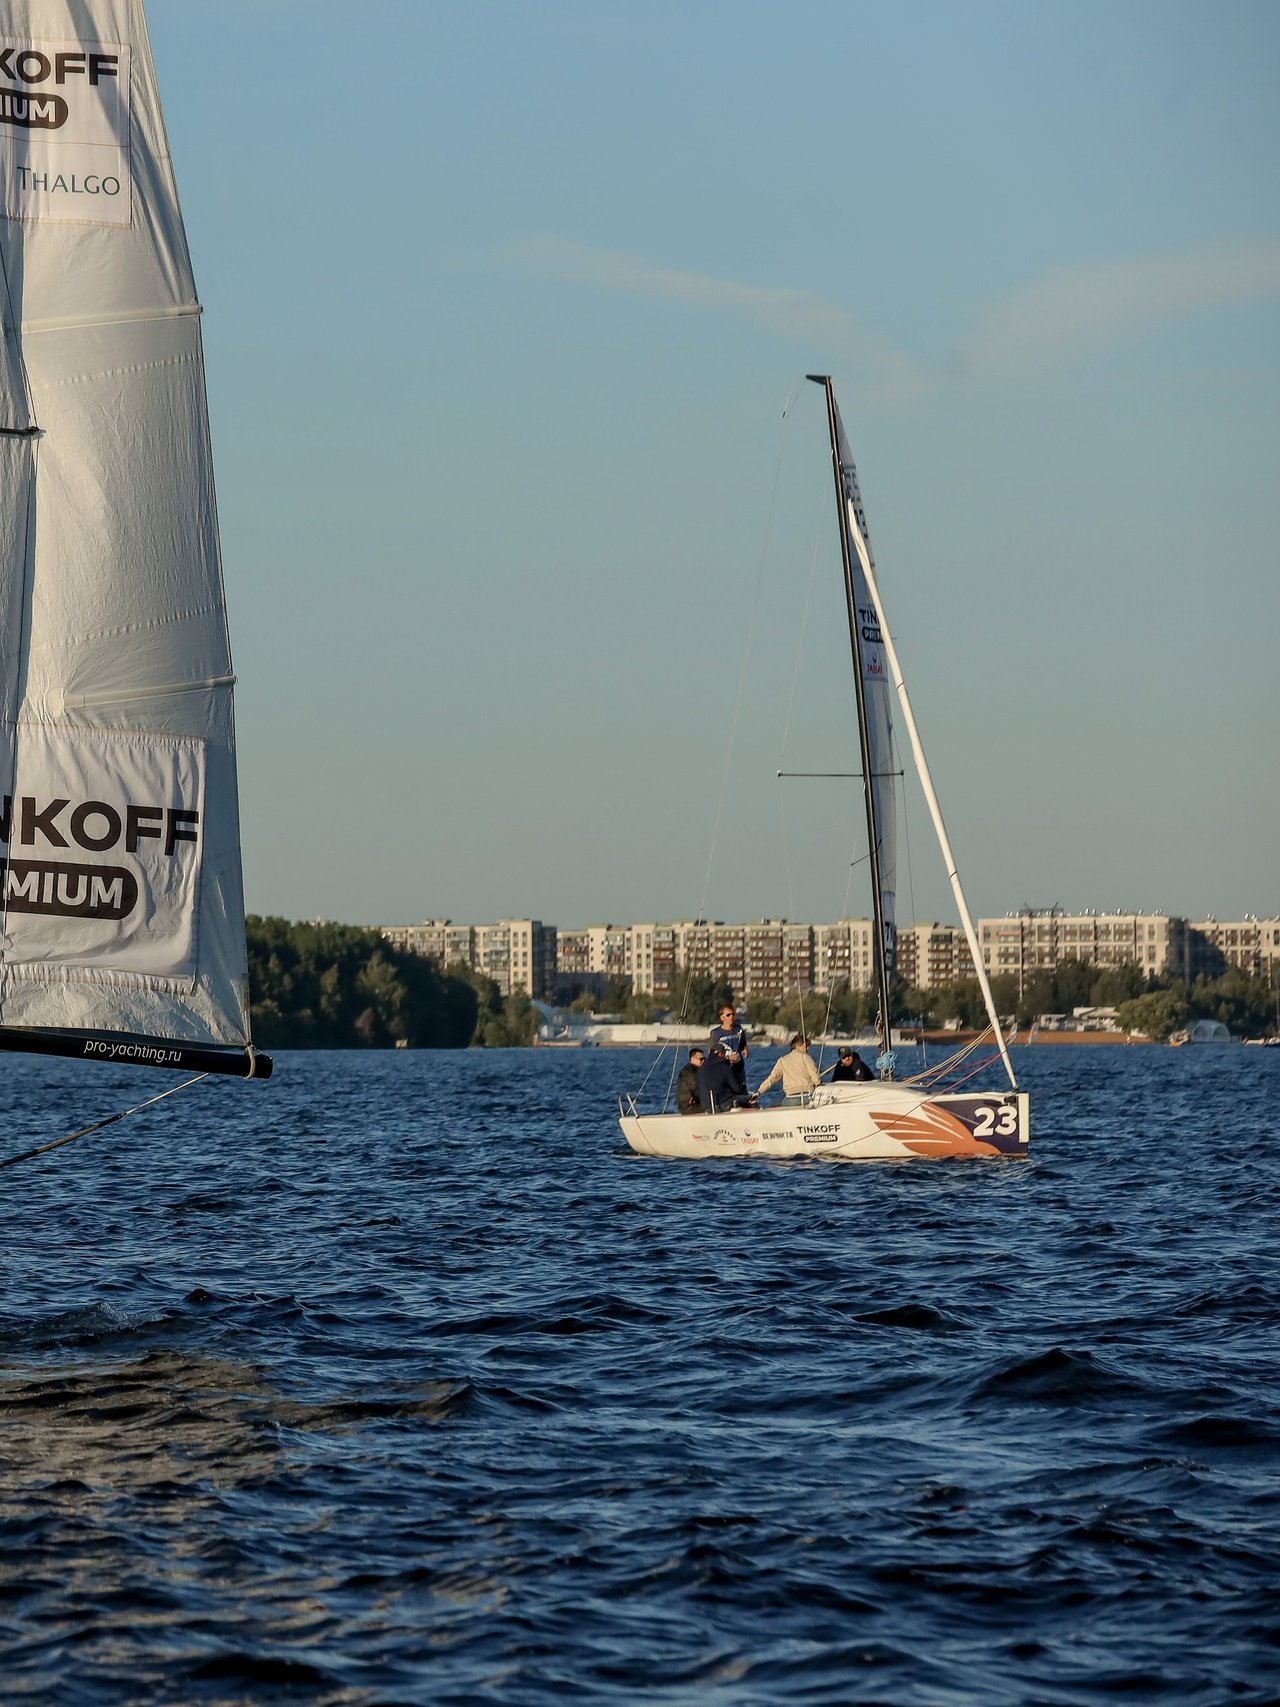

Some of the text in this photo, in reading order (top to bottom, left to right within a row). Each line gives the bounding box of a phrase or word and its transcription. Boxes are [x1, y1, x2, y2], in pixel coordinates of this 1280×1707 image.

[17, 166, 120, 196] THALGO
[83, 1040, 182, 1063] pro-yachting.ru
[796, 1124, 841, 1134] TINKOFF
[973, 1105, 1018, 1137] 23
